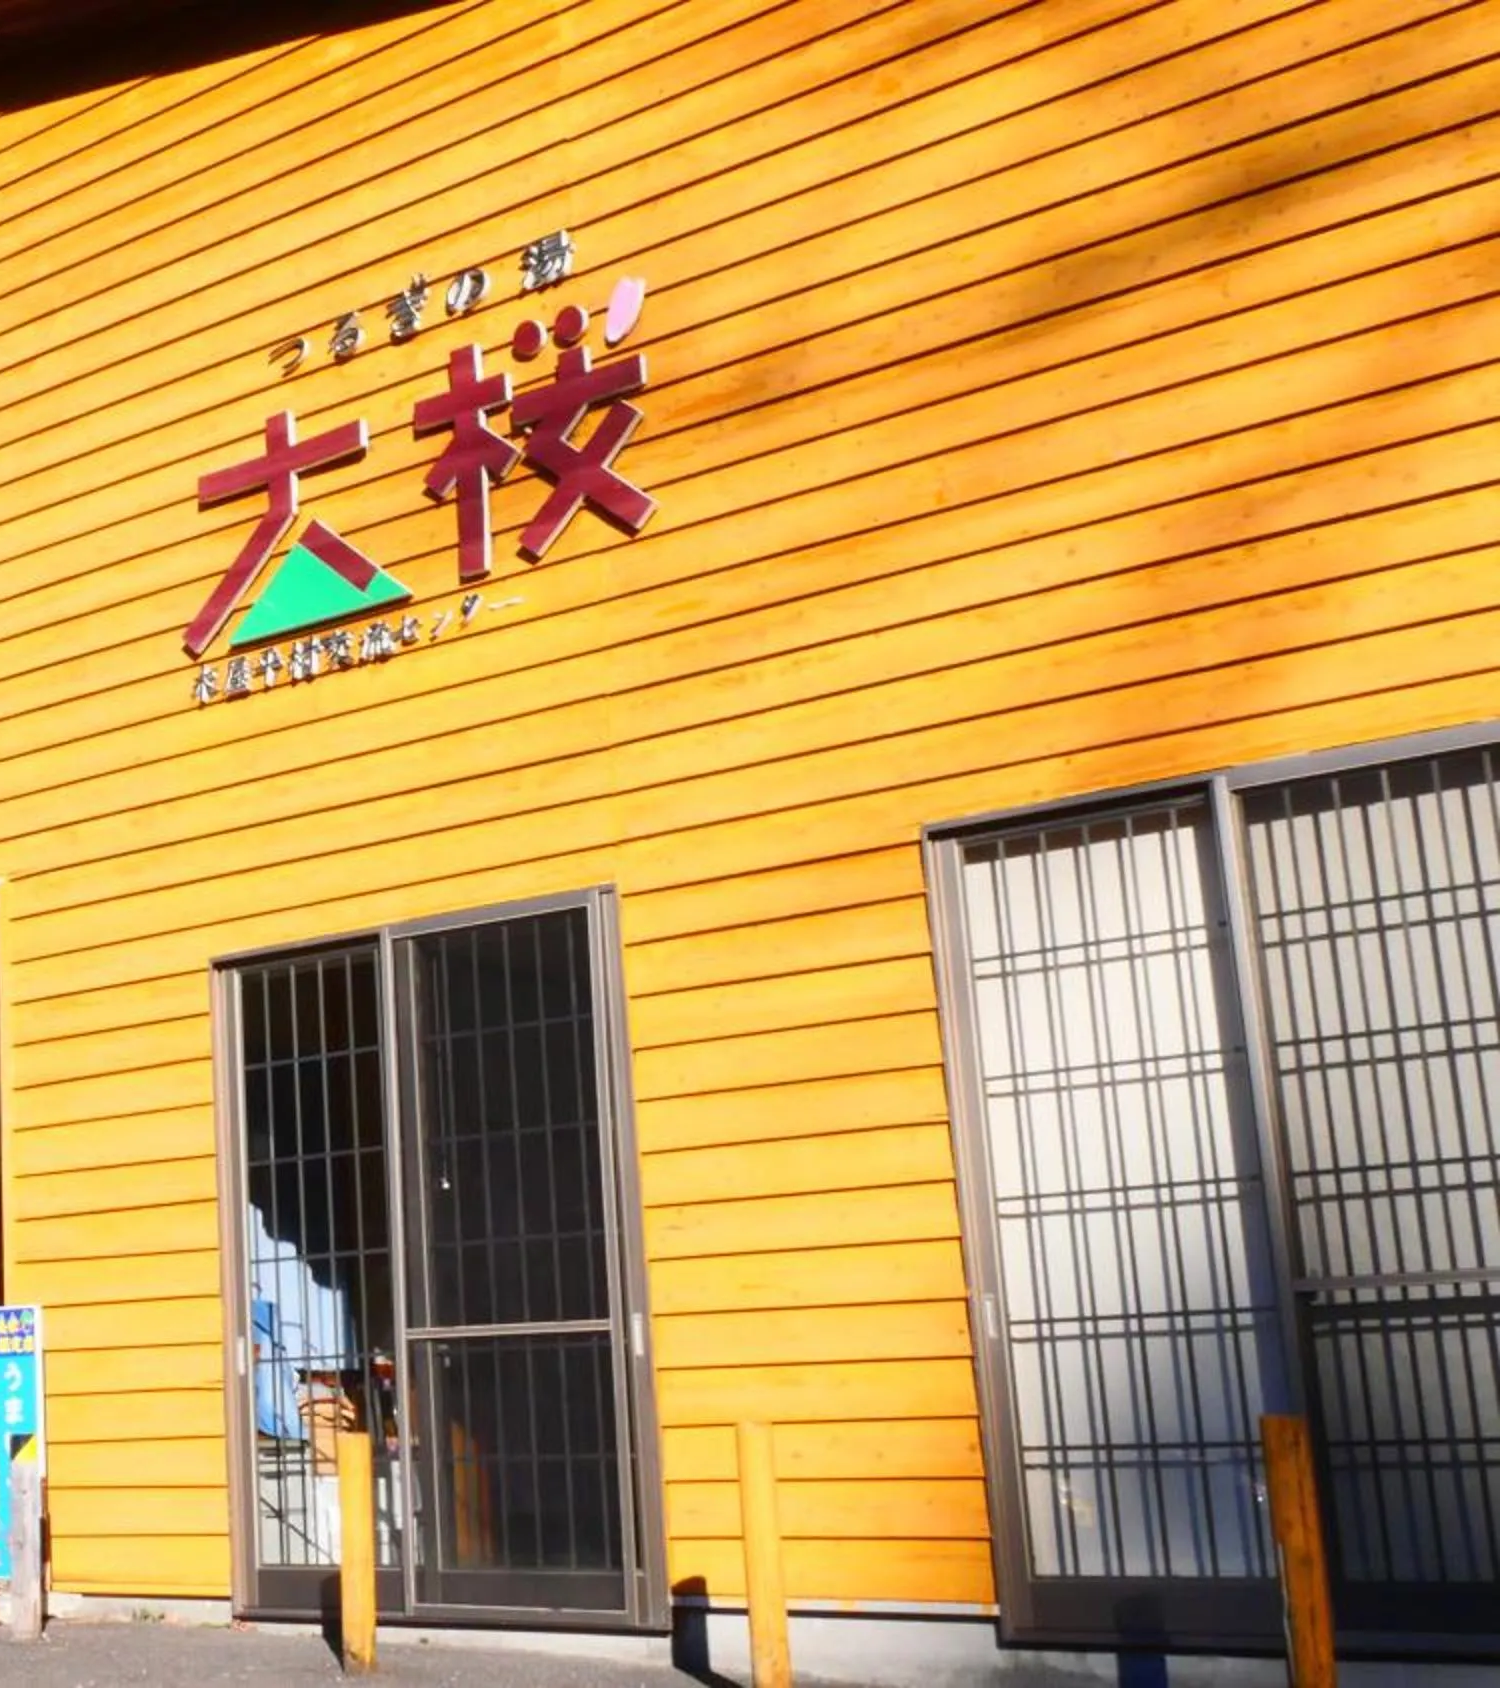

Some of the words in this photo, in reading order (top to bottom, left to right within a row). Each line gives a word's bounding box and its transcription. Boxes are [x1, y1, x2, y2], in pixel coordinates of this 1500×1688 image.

[267, 229, 576, 379] つるぎの湯
[183, 277, 660, 661] 大桜
